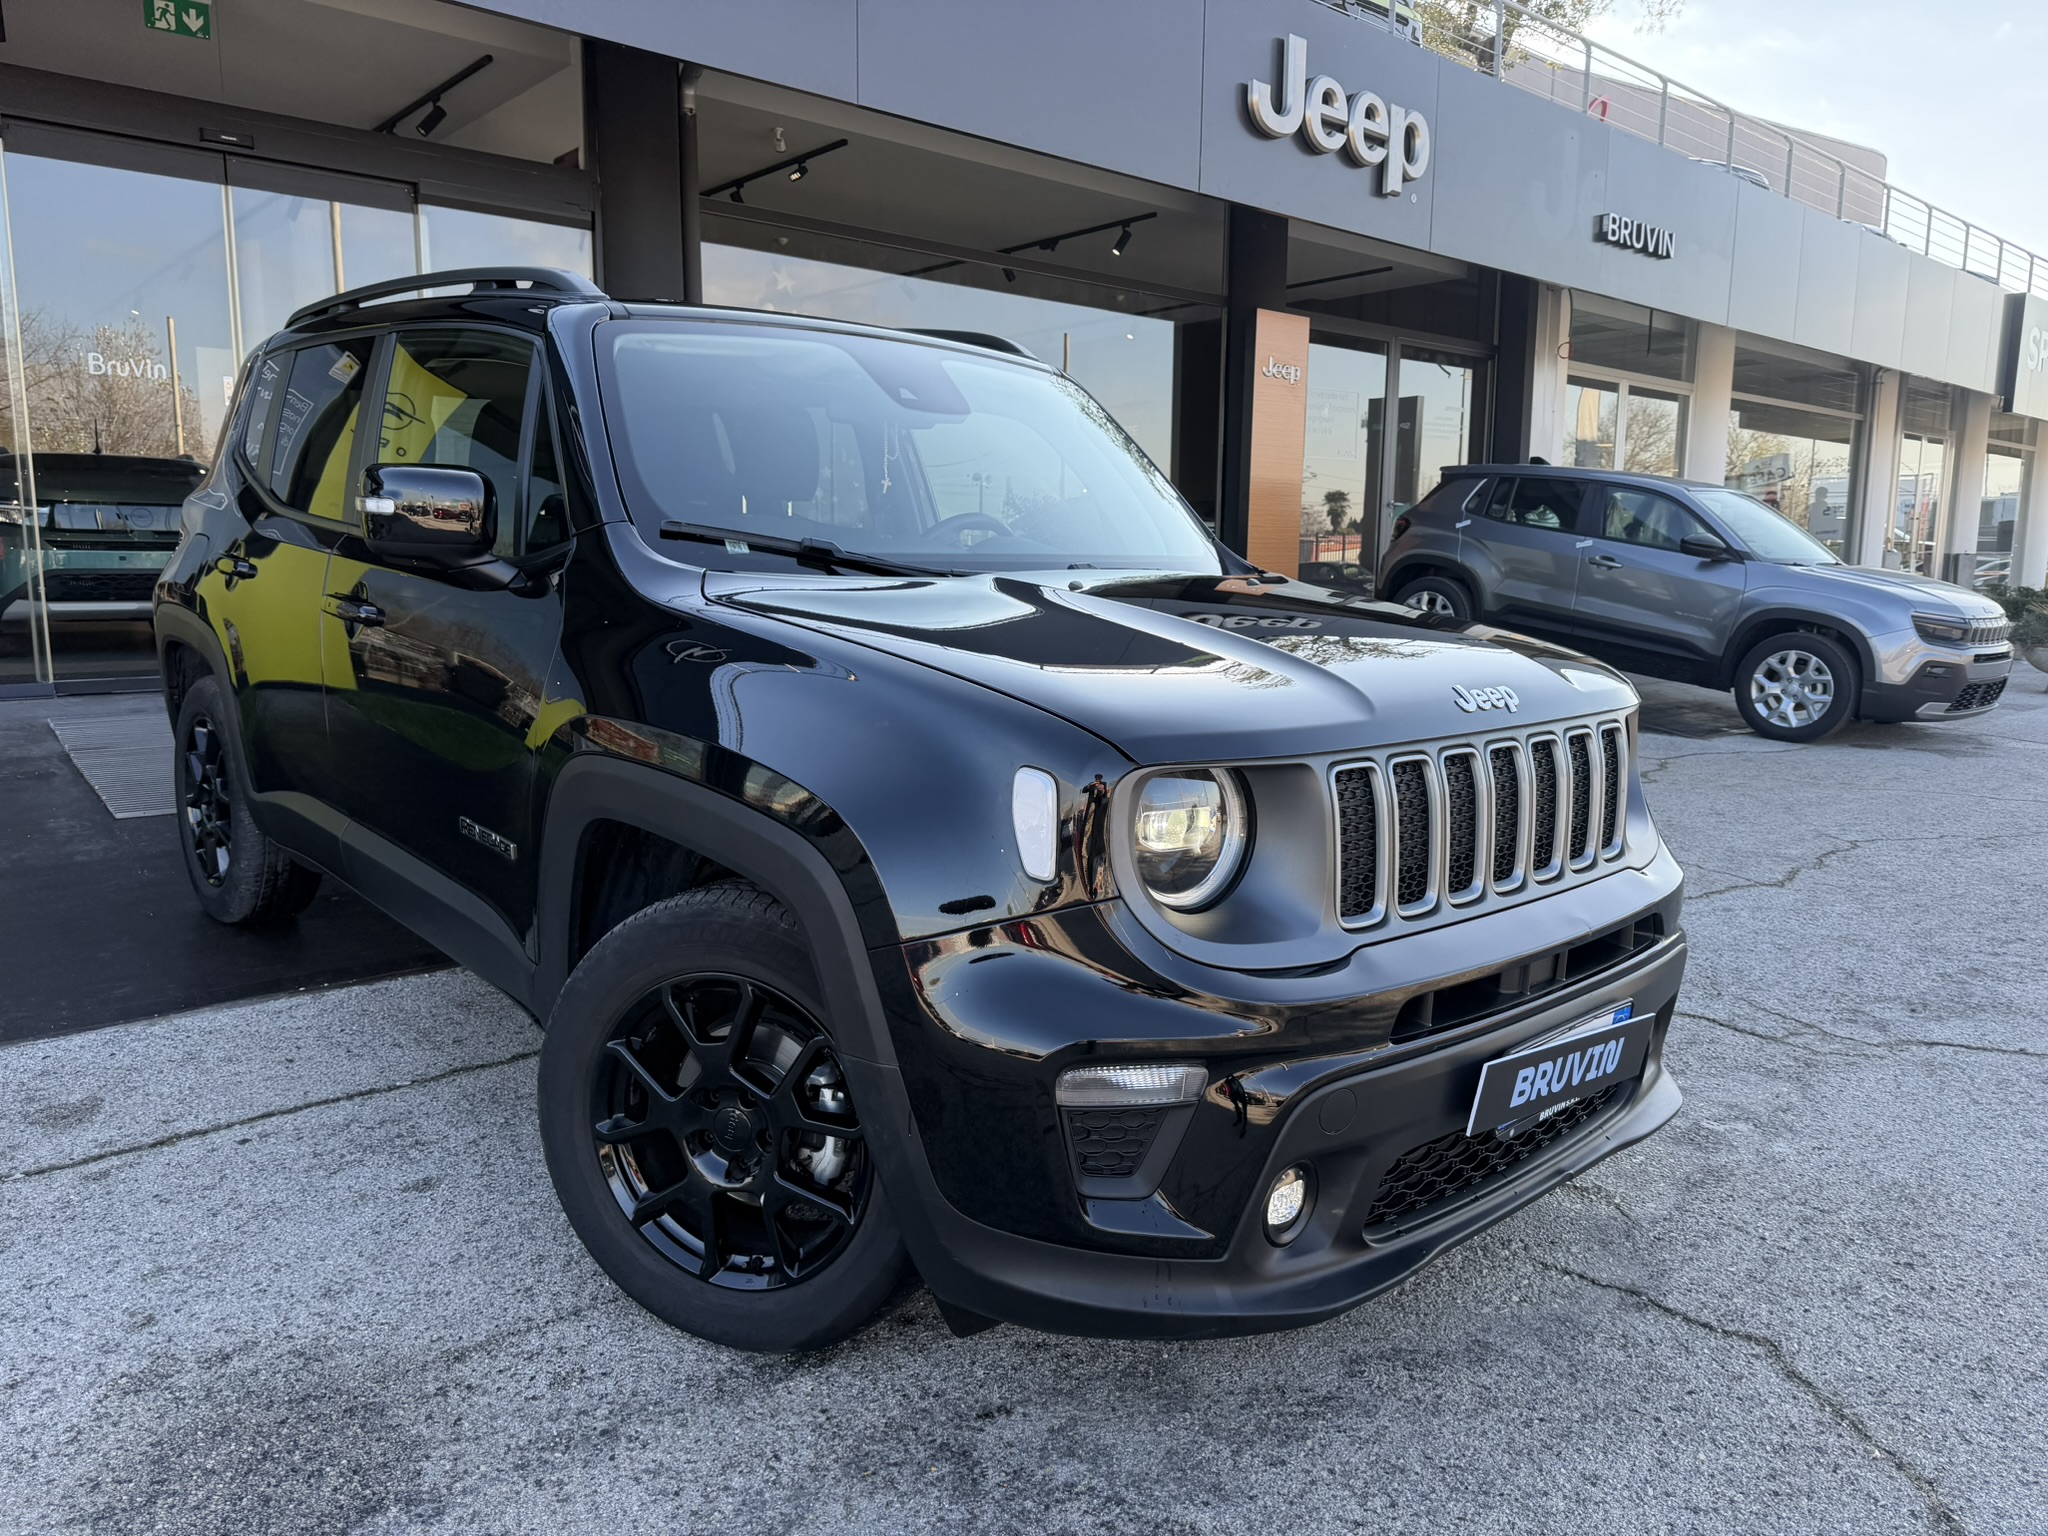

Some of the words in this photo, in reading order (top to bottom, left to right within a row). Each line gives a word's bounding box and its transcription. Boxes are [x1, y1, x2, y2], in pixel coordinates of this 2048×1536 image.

[1248, 32, 1430, 196] Jeep
[1607, 212, 1676, 259] BRUVIN
[1262, 356, 1300, 385] Jeep
[1451, 684, 1520, 713] Jeep
[1509, 1036, 1626, 1108] BRUVIN
[1539, 1101, 1566, 1121] BRUVIN
